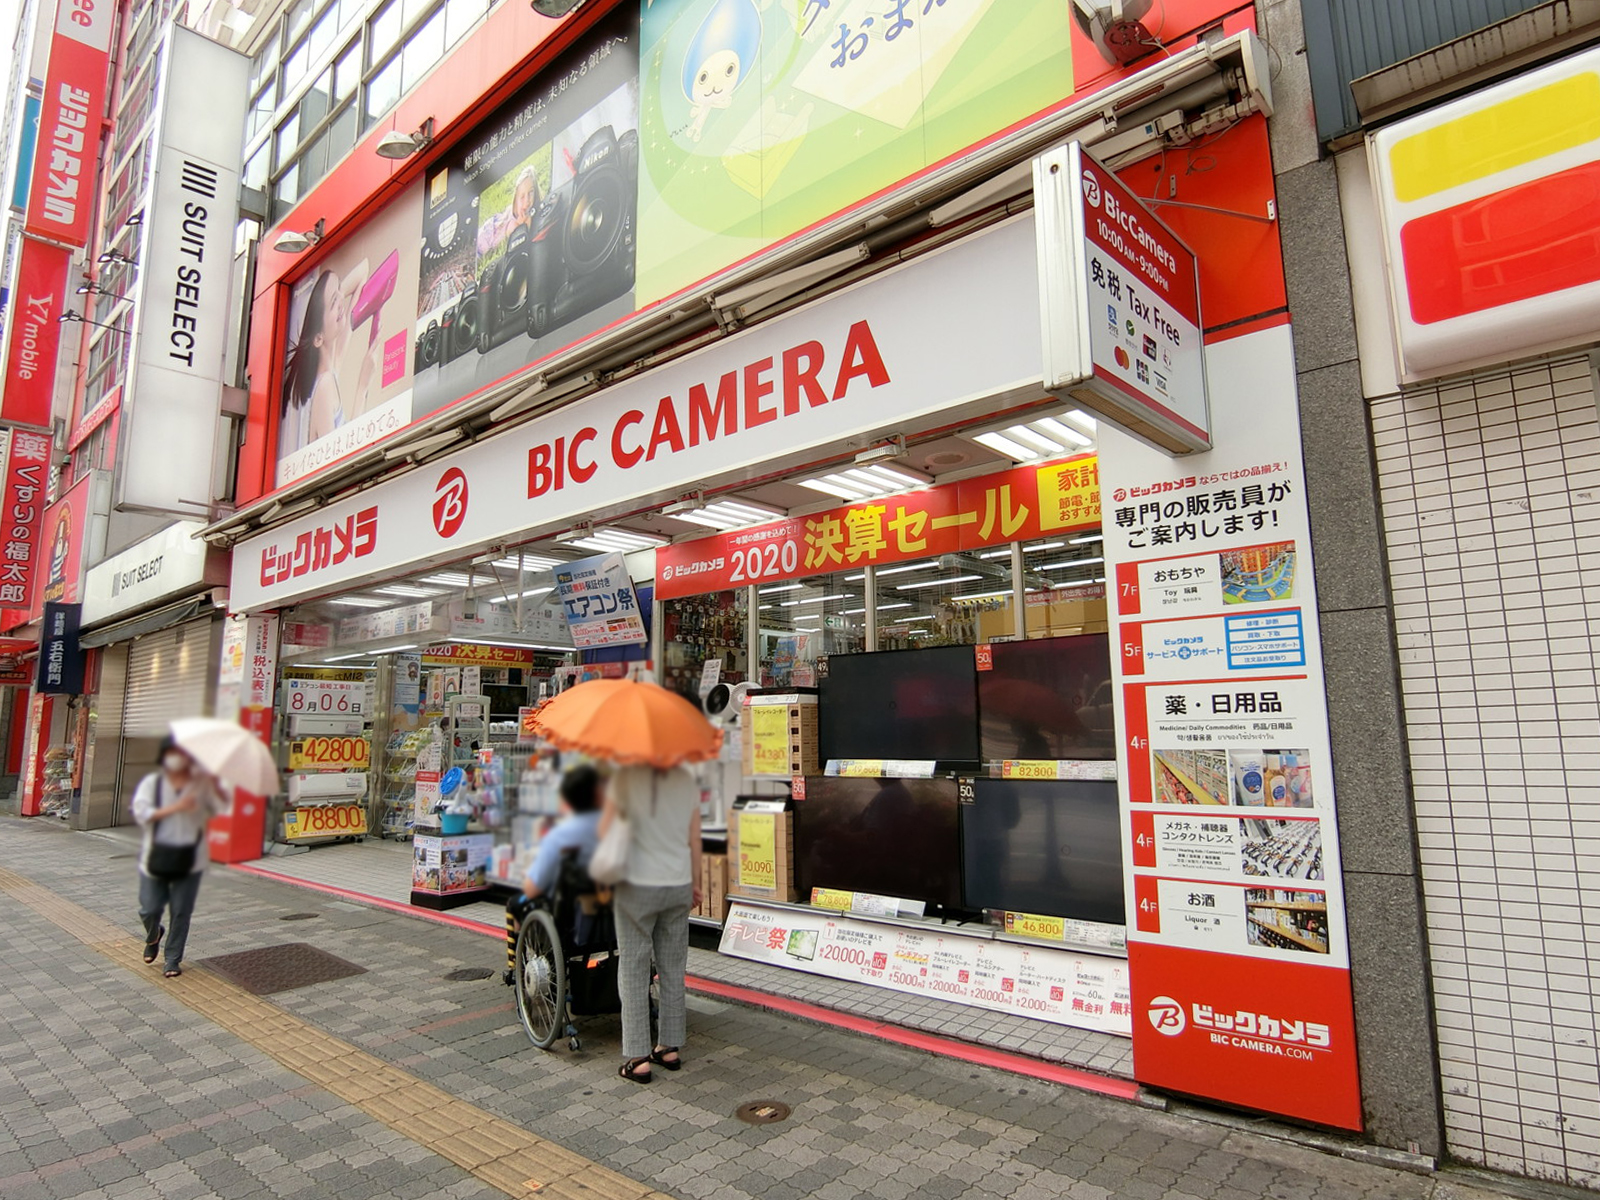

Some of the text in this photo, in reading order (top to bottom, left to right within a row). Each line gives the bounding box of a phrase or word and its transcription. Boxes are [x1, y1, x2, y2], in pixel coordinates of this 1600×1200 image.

[584, 146, 609, 169] Nikon
[1104, 190, 1176, 275] BicCamera
[169, 203, 208, 367] SUIT SELECT
[1126, 284, 1150, 325] Tax
[1154, 305, 1180, 347] Free
[527, 319, 890, 499] BIC CAMERA
[14, 433, 49, 462] 薬
[1130, 476, 1197, 498] ビックカメラ
[1115, 479, 1292, 528] 専門の販売員が
[1, 465, 41, 602] くすりの福太郎
[804, 485, 1029, 569] 決算セール
[261, 505, 378, 587] ビックカメラ
[136, 556, 163, 584] SELECT
[675, 557, 725, 577] ビックカメラ
[729, 540, 798, 582] 2020
[1154, 568, 1206, 583] おもちゃ
[1120, 582, 1138, 597] 7F
[1164, 589, 1178, 597] Toy
[564, 587, 635, 619] エアコン祭
[1124, 642, 1142, 657] 5F
[1164, 636, 1203, 646] ビックカメラ
[1146, 646, 1224, 660] サービス サポート
[1165, 691, 1283, 715] 薬・日用品
[1130, 735, 1148, 749] 4F
[1162, 831, 1234, 844] コンタクトレンズ
[1166, 821, 1229, 833] メガネ・補聴器
[1136, 836, 1153, 848] 4F
[1140, 899, 1157, 912] 4F
[1187, 892, 1215, 908] お酒
[1184, 914, 1208, 924] Liquor
[729, 923, 787, 950] テレビ祭
[1071, 998, 1104, 1015] 無金利
[1192, 1003, 1330, 1047] ビックカメラ
[1210, 1032, 1229, 1046] BIC
